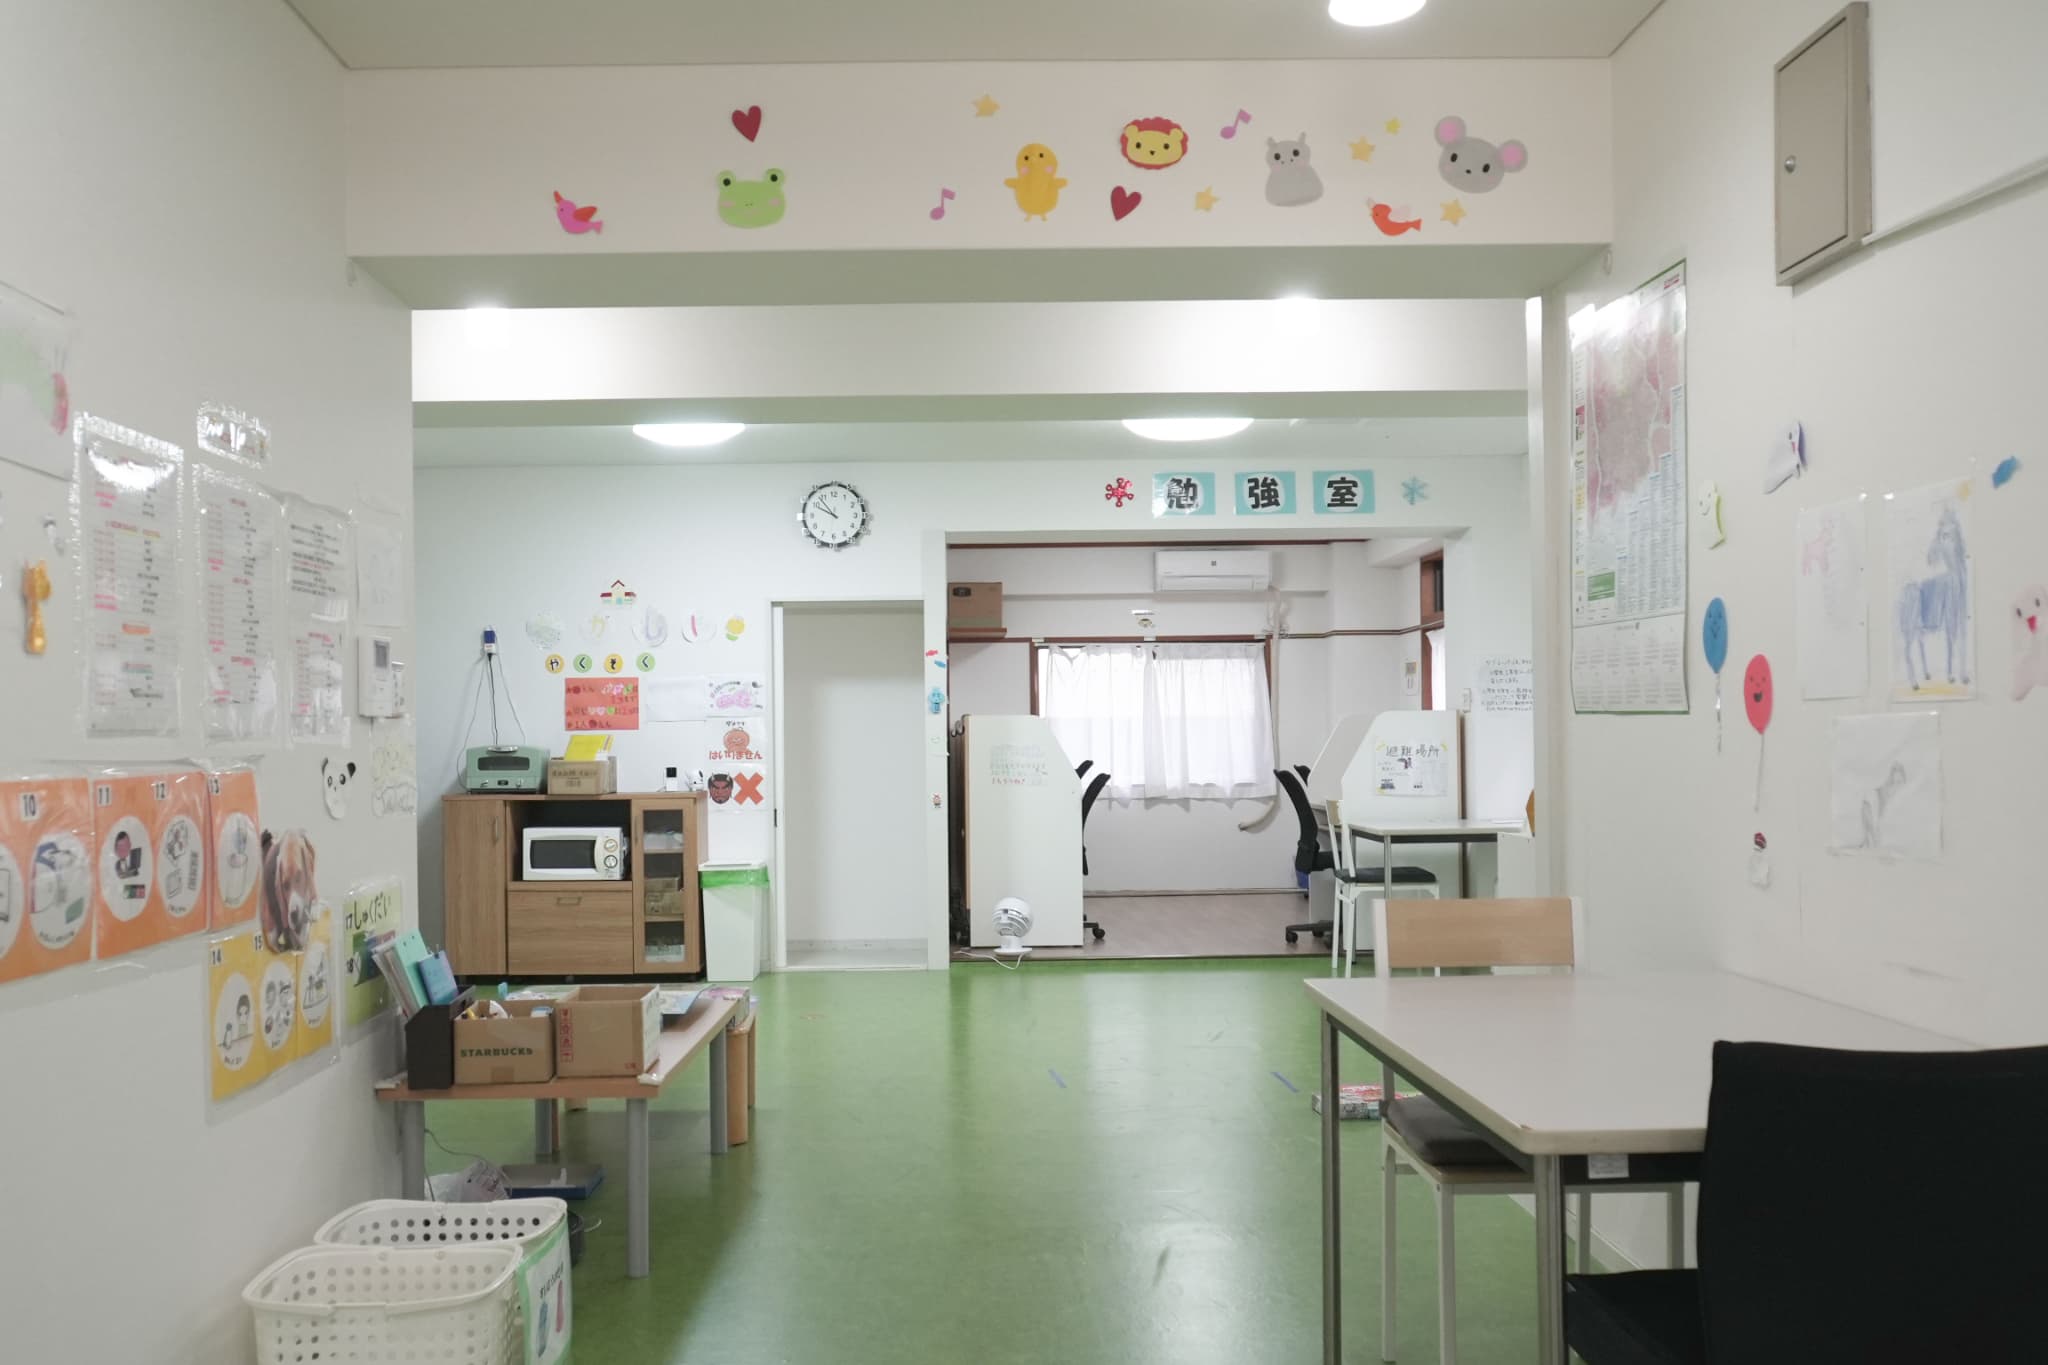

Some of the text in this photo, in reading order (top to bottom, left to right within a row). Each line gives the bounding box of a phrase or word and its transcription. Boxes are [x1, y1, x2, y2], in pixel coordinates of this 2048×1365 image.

[1167, 476, 1358, 509] 勉強室
[550, 656, 649, 670] やくそく
[709, 751, 763, 760] はいりません
[155, 783, 166, 799] 12
[209, 778, 220, 794] 13
[98, 787, 110, 805] 11
[23, 794, 37, 817] 10
[255, 936, 263, 952] 15
[212, 951, 221, 965] 14
[460, 1047, 533, 1058] STARBUCKS
